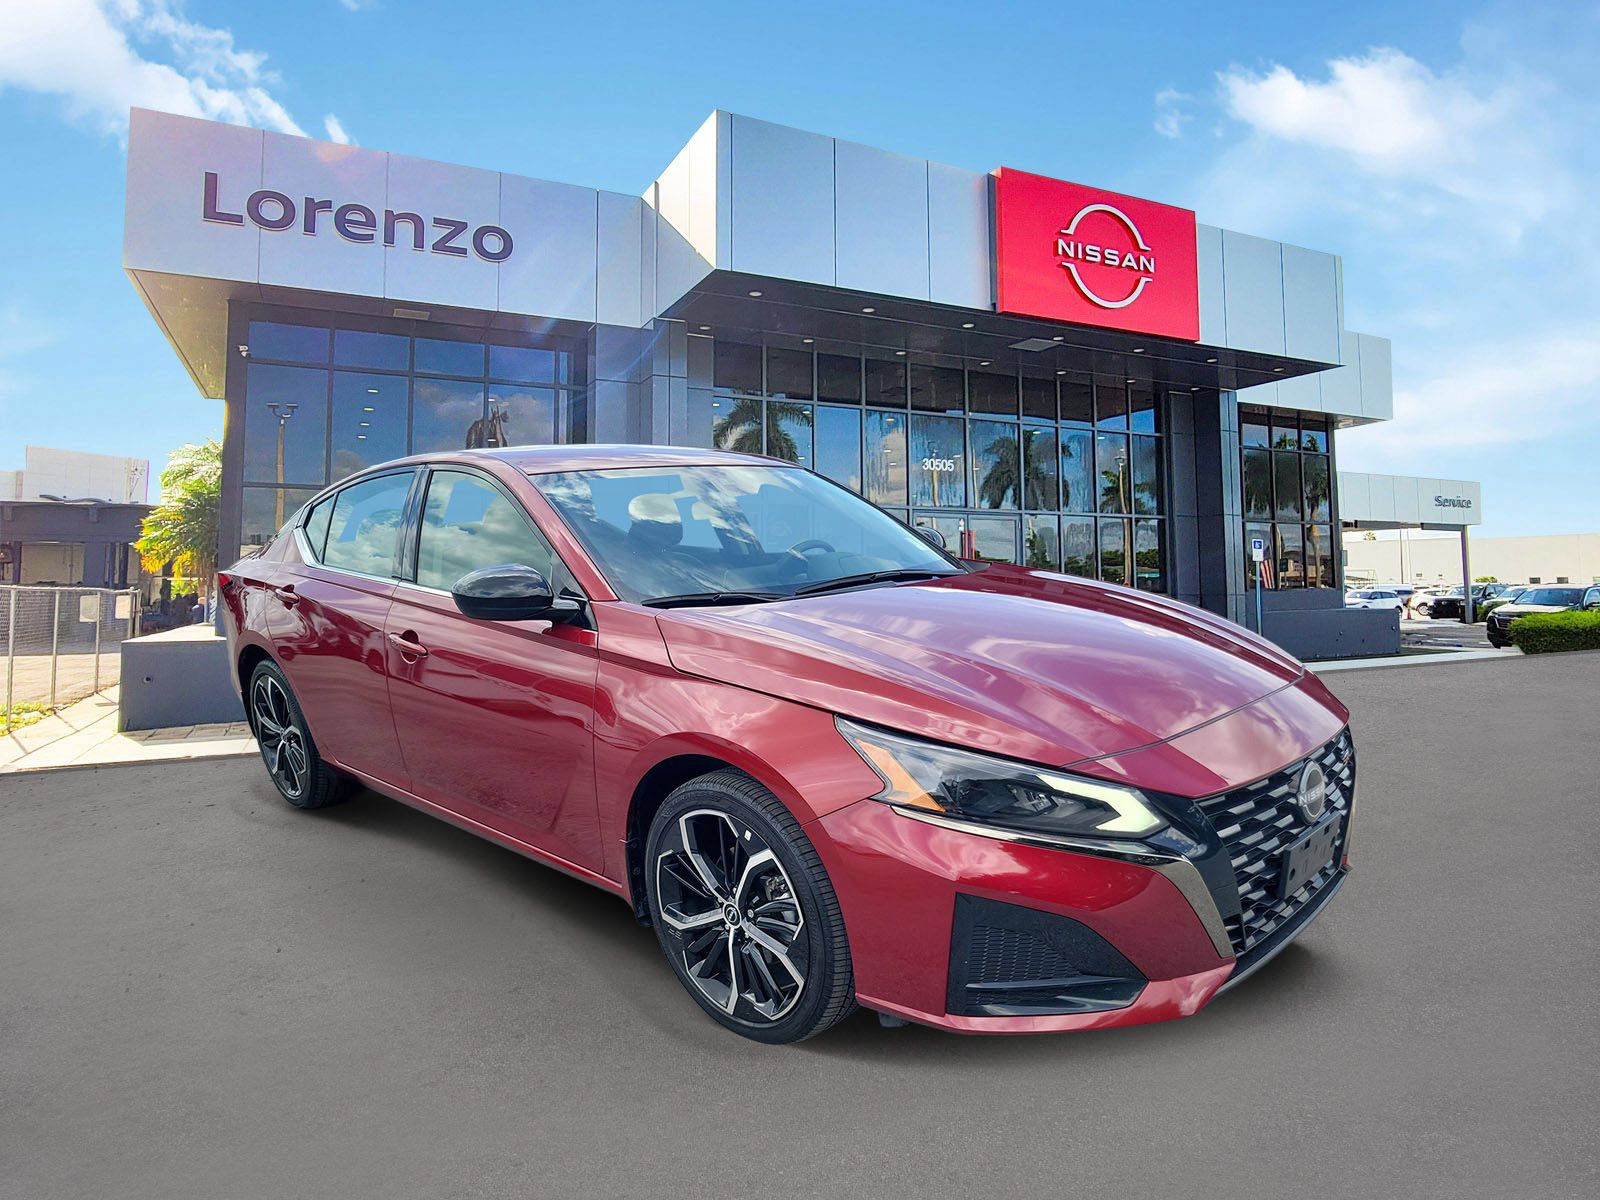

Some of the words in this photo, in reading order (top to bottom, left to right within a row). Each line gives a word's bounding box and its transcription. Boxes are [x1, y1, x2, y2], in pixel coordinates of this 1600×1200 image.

[203, 170, 514, 263] Lorenzo
[1057, 238, 1155, 273] NISSAN
[922, 458, 955, 472] 30505
[1434, 495, 1472, 509] Service
[1299, 784, 1325, 807] NISS
